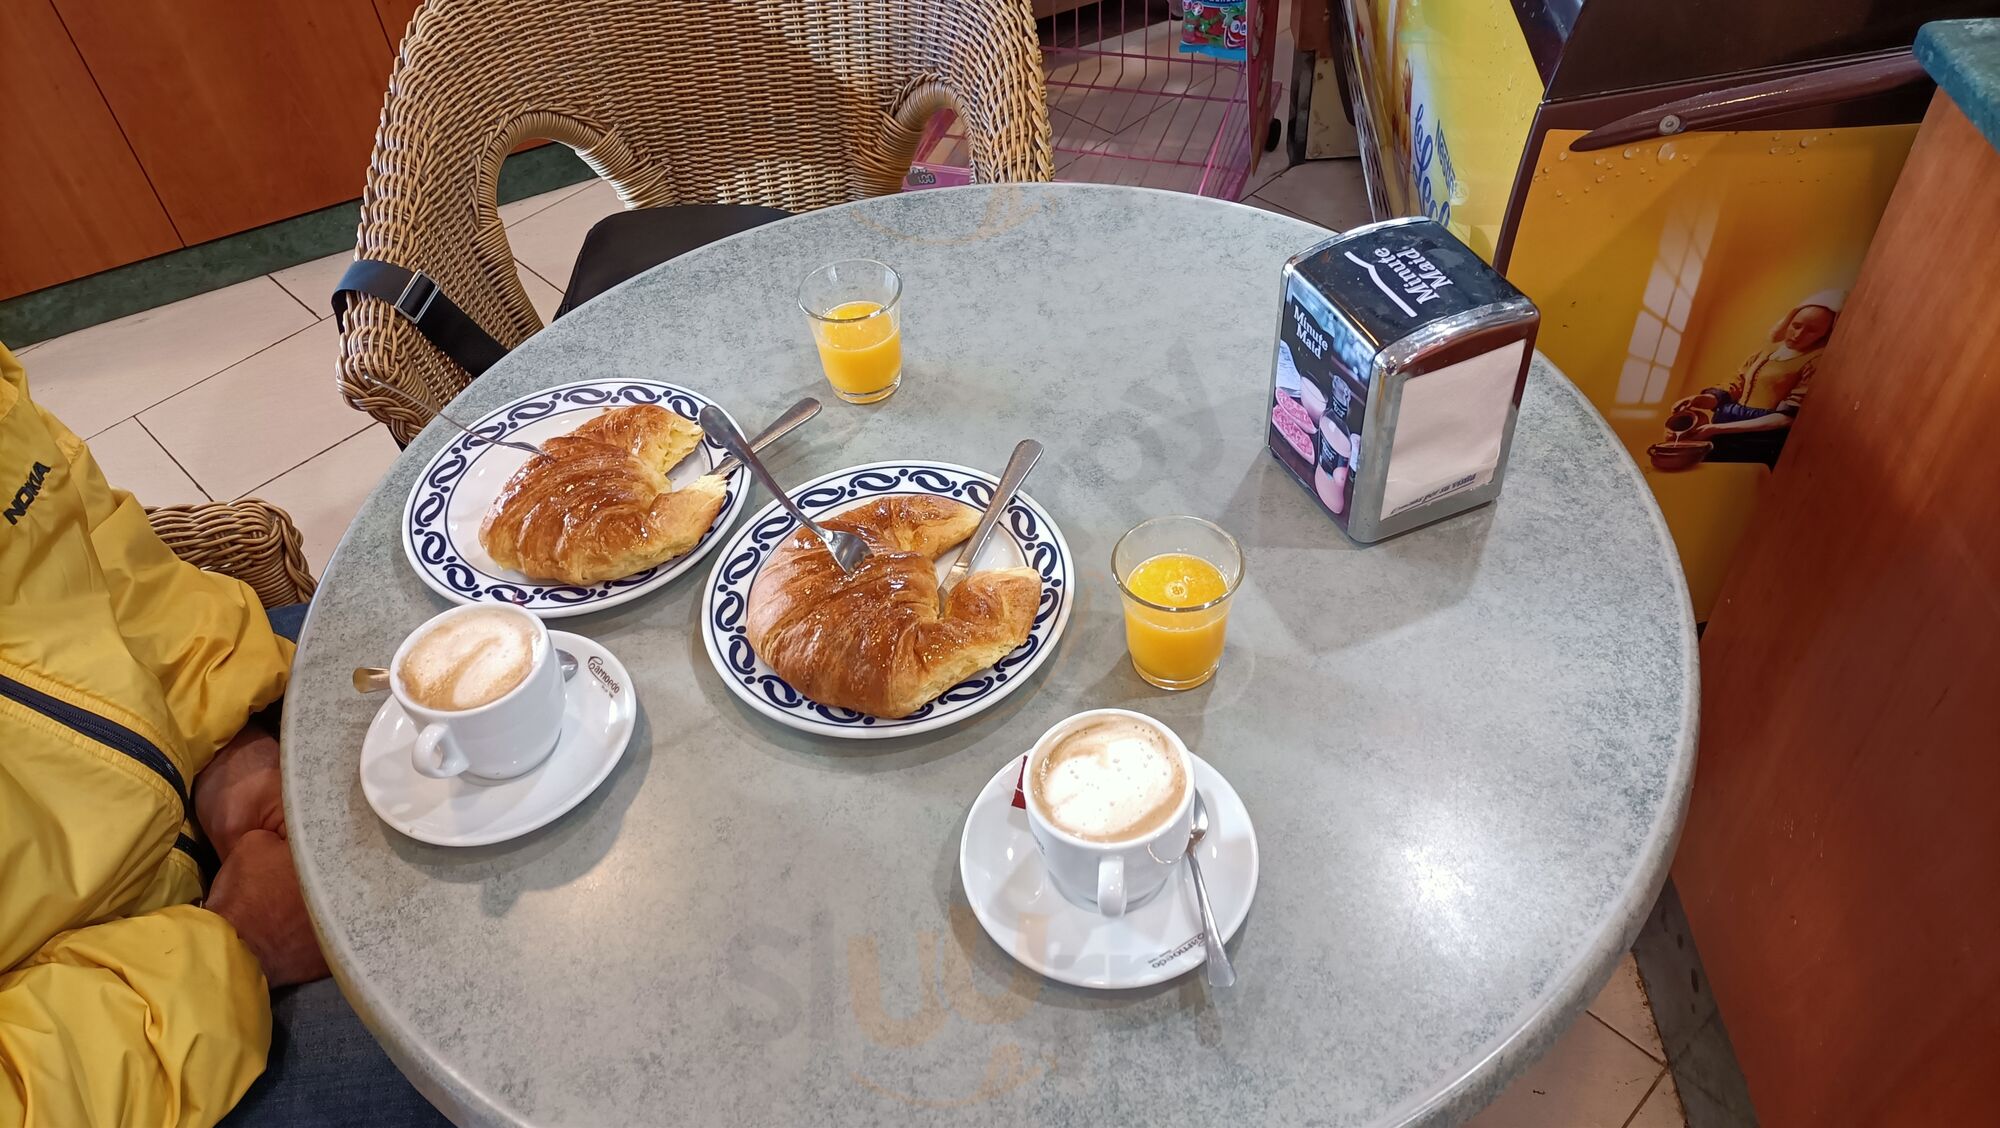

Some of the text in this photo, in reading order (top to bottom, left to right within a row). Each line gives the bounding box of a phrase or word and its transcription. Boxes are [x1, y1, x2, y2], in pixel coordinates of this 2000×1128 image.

[1374, 247, 1440, 305] Minute
[1396, 246, 1454, 290] Maid
[1293, 304, 1328, 351] Minute
[1296, 322, 1322, 360] Maid
[3, 461, 51, 525] NOKIA
